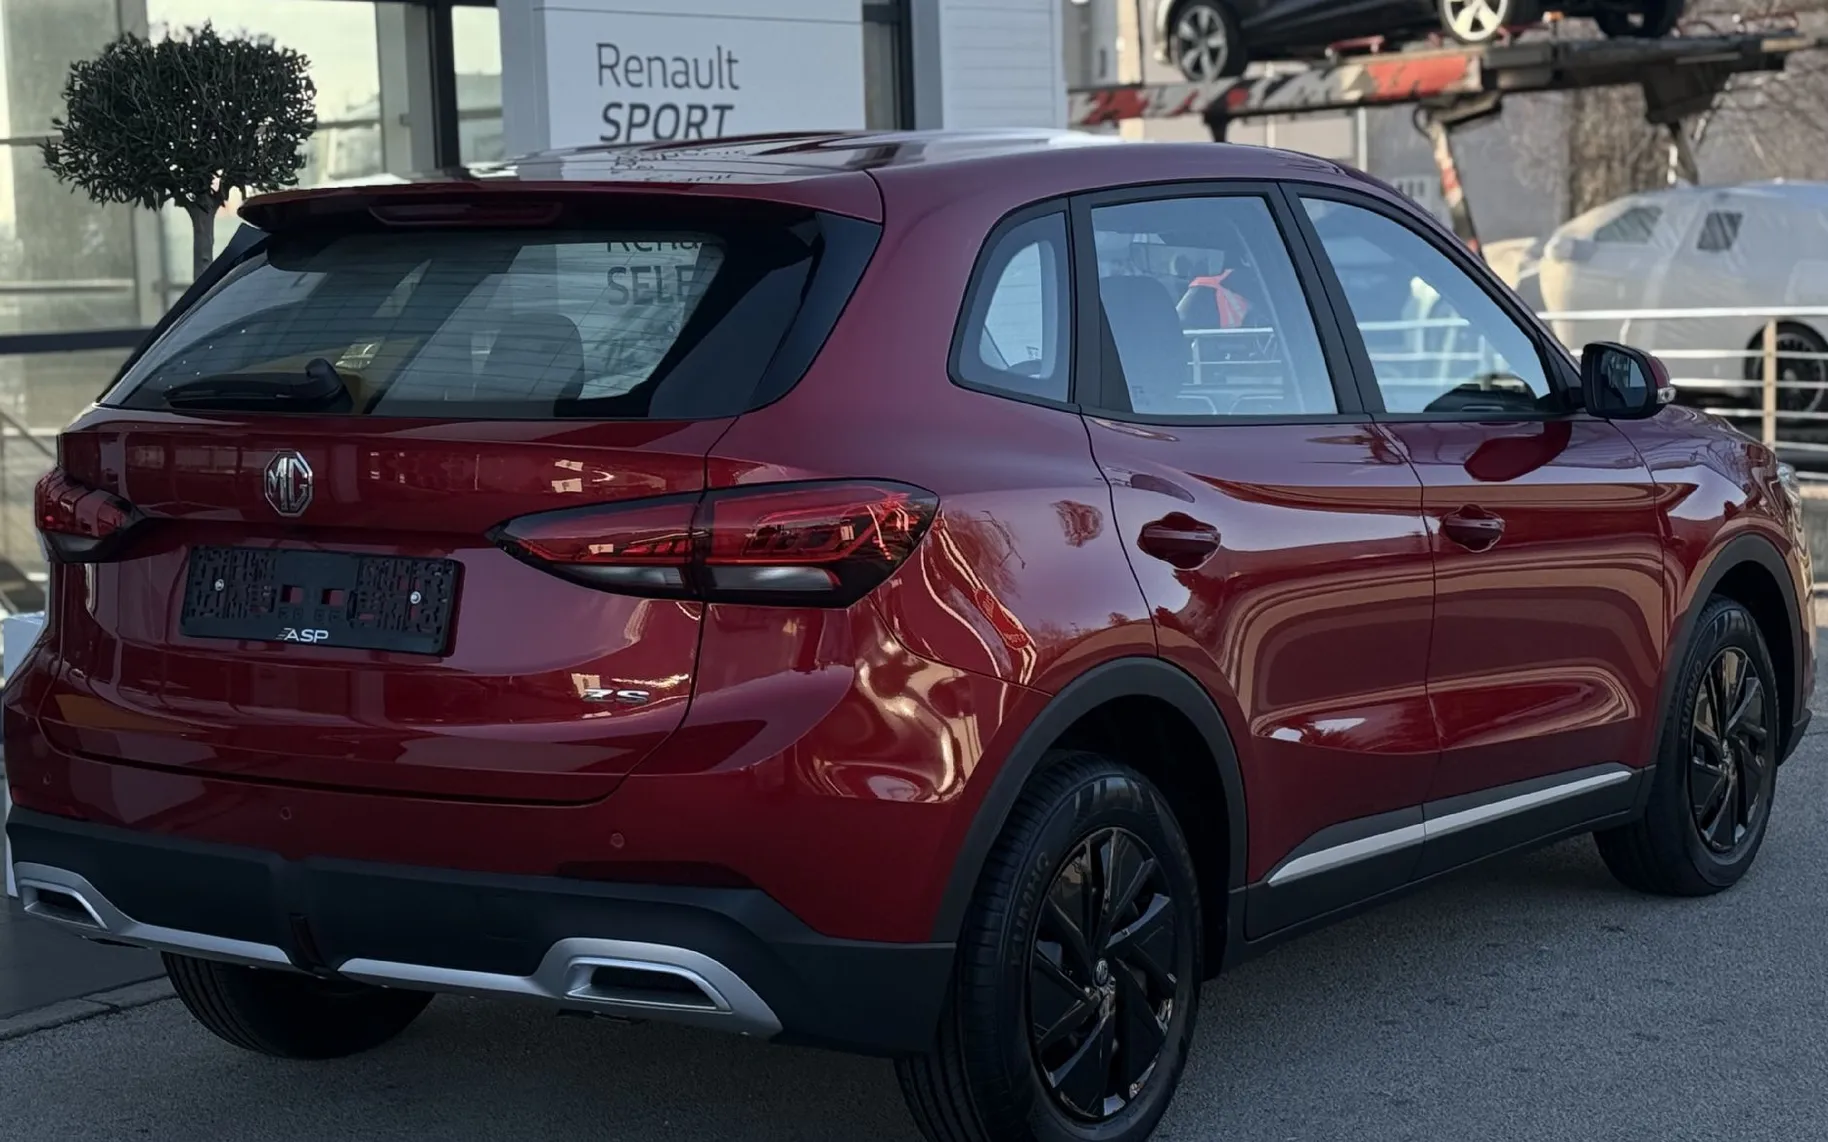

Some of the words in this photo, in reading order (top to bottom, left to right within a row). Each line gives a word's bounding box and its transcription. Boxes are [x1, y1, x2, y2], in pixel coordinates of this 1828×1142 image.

[596, 43, 740, 90] Renault
[599, 102, 735, 143] SPORT
[267, 456, 310, 511] MG
[280, 627, 329, 643] ASP
